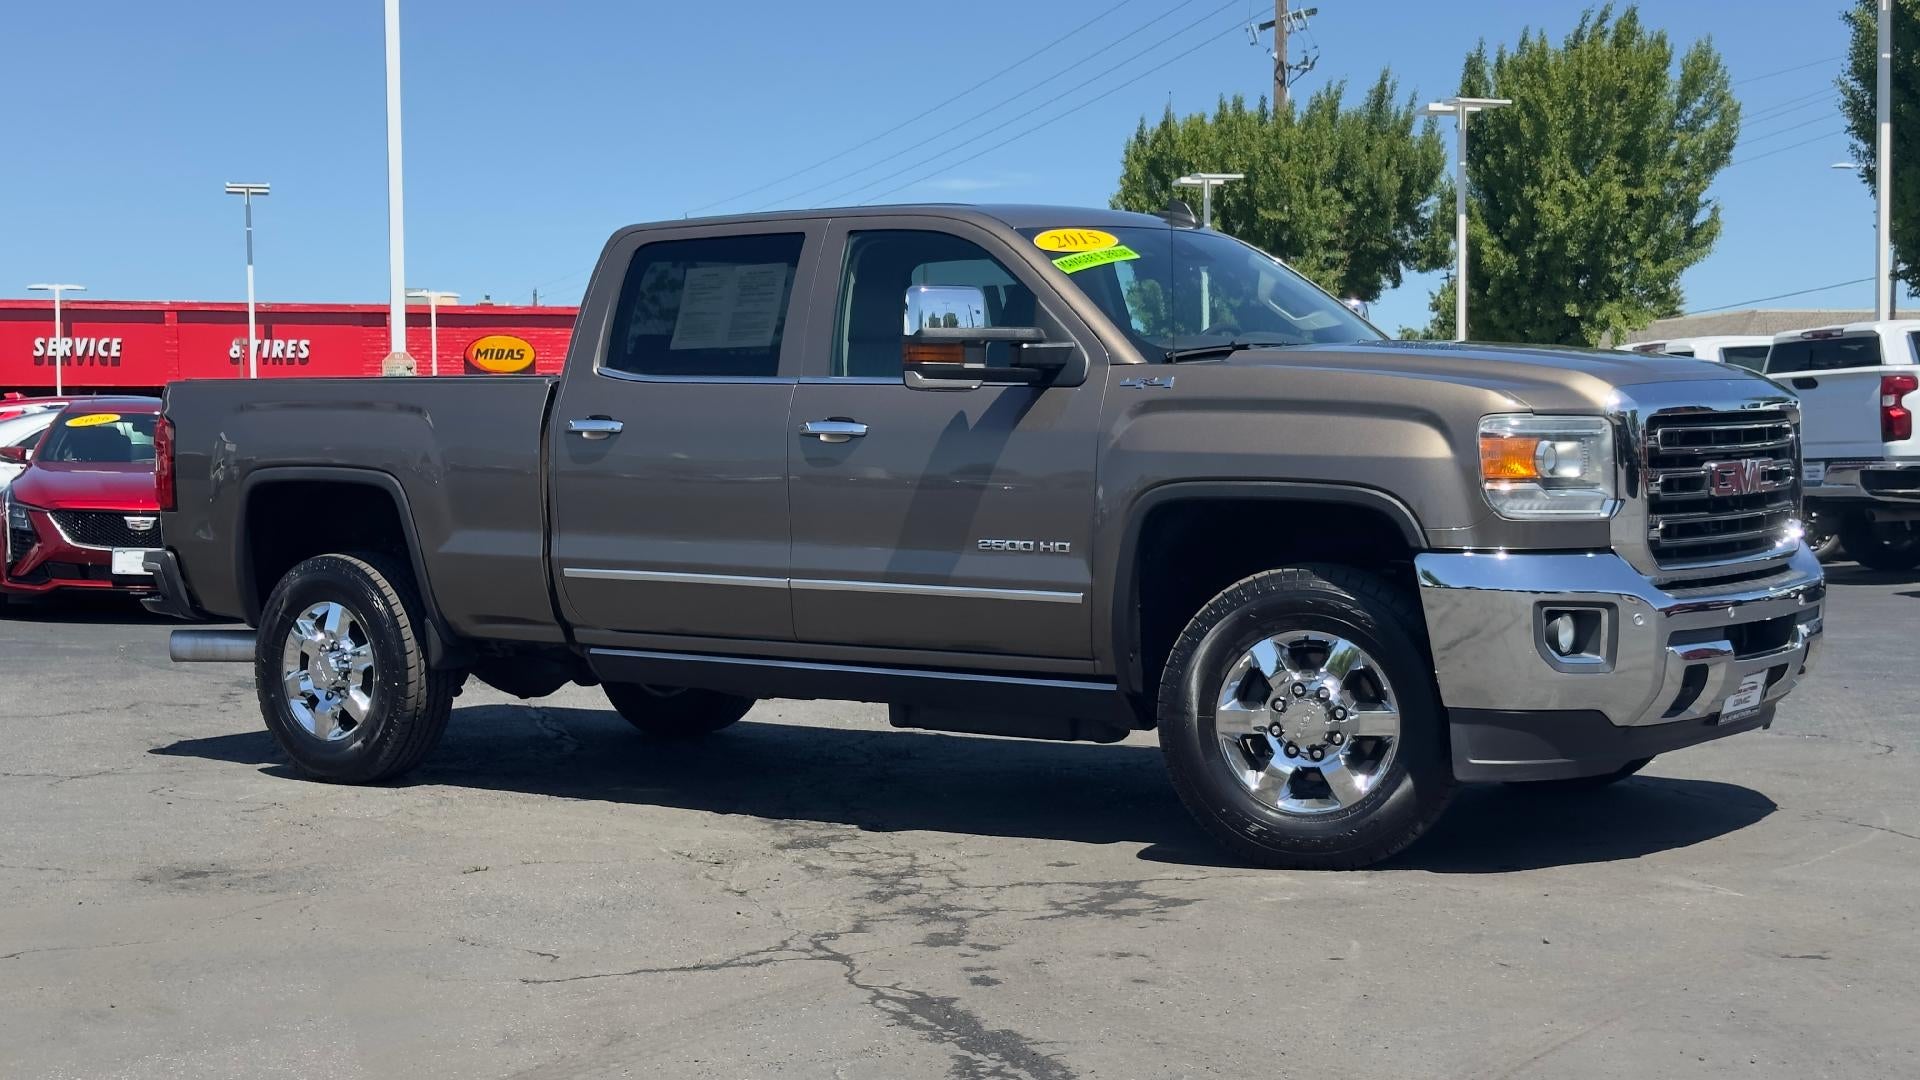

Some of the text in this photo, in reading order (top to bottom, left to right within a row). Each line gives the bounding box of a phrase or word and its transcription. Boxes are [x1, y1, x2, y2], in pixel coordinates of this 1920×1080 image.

[1048, 231, 1101, 248] 2015
[33, 337, 122, 357] SERVICE
[250, 338, 311, 359] TIRES
[474, 347, 526, 361] MIDAS
[1709, 458, 1775, 497] GMC
[978, 539, 1071, 553] 2500 HD
